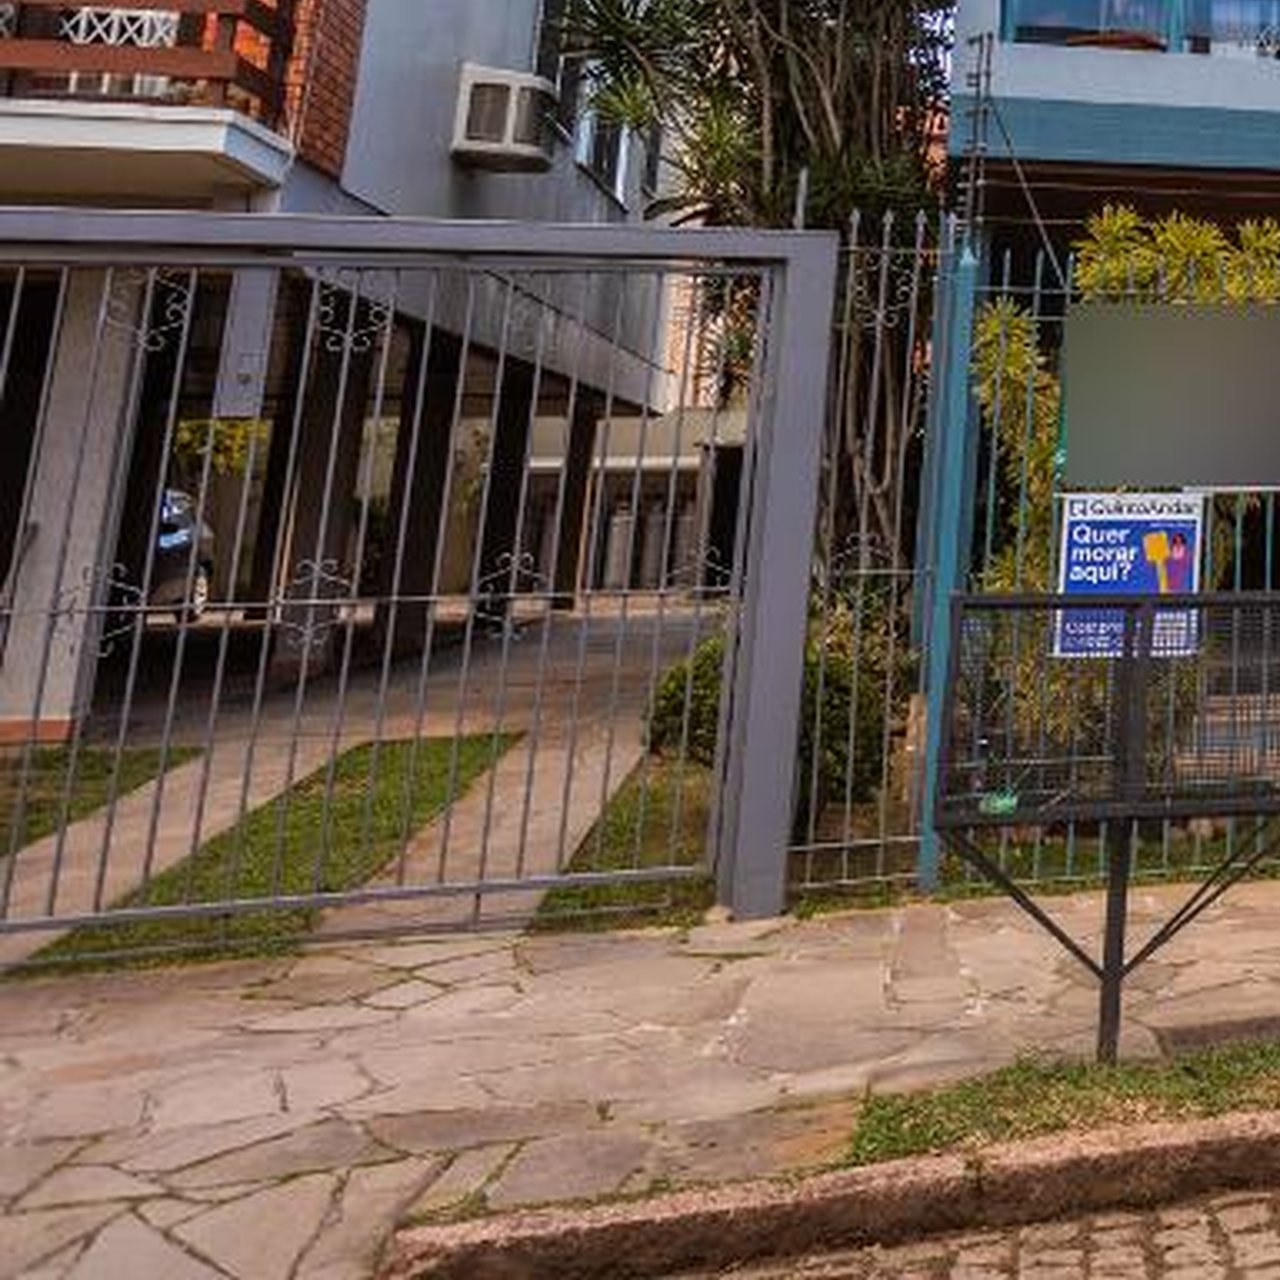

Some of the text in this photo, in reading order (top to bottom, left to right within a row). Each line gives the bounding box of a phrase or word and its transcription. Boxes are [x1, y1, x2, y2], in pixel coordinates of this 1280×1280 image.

[1072, 524, 1130, 544] Quer
[1072, 546, 1138, 562] morar
[1069, 562, 1132, 584] aqui?
